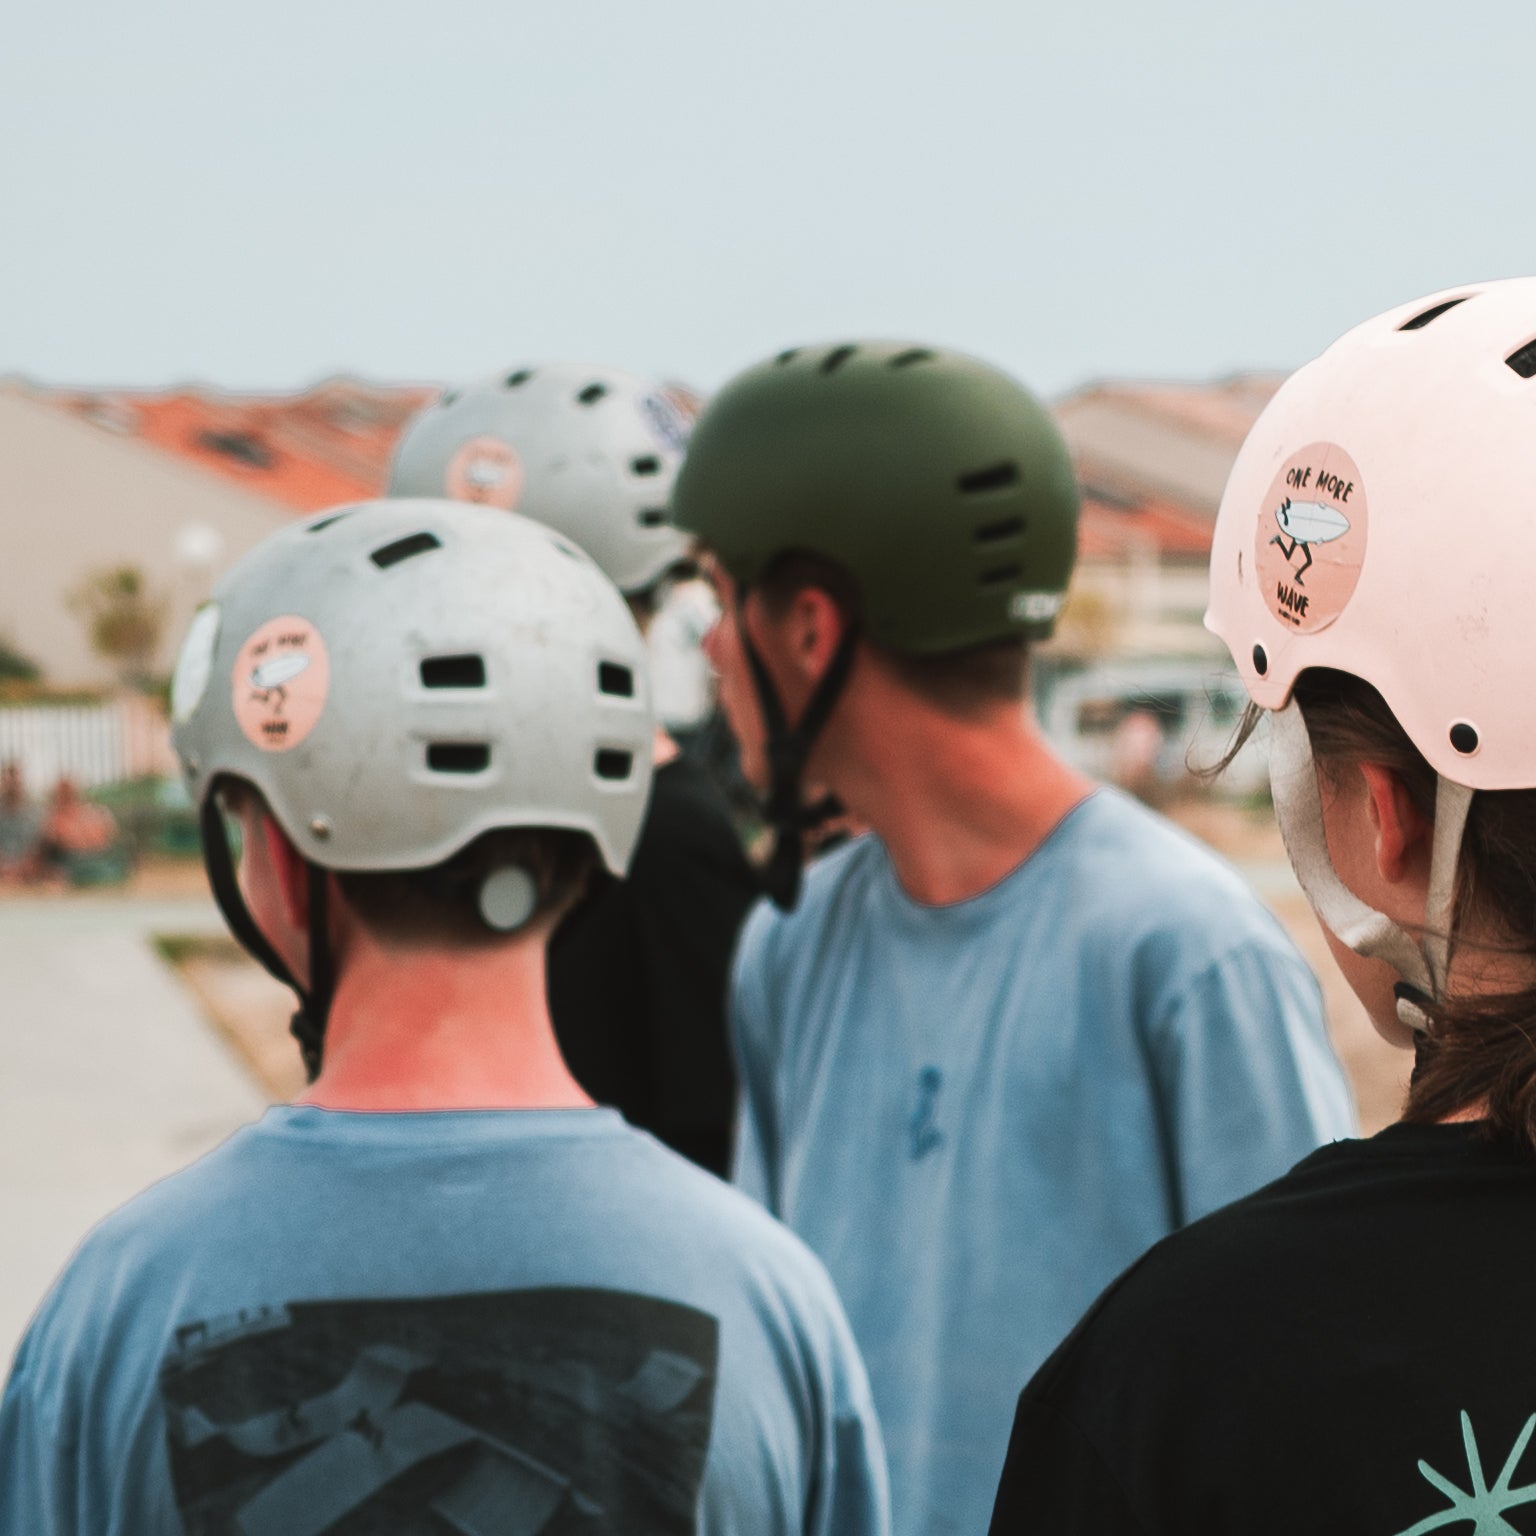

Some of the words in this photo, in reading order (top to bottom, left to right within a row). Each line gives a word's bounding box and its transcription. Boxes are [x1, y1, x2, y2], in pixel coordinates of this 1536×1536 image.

[1286, 466, 1312, 490] ONE
[1315, 470, 1354, 503] MORE
[1277, 581, 1309, 618] WAVE
